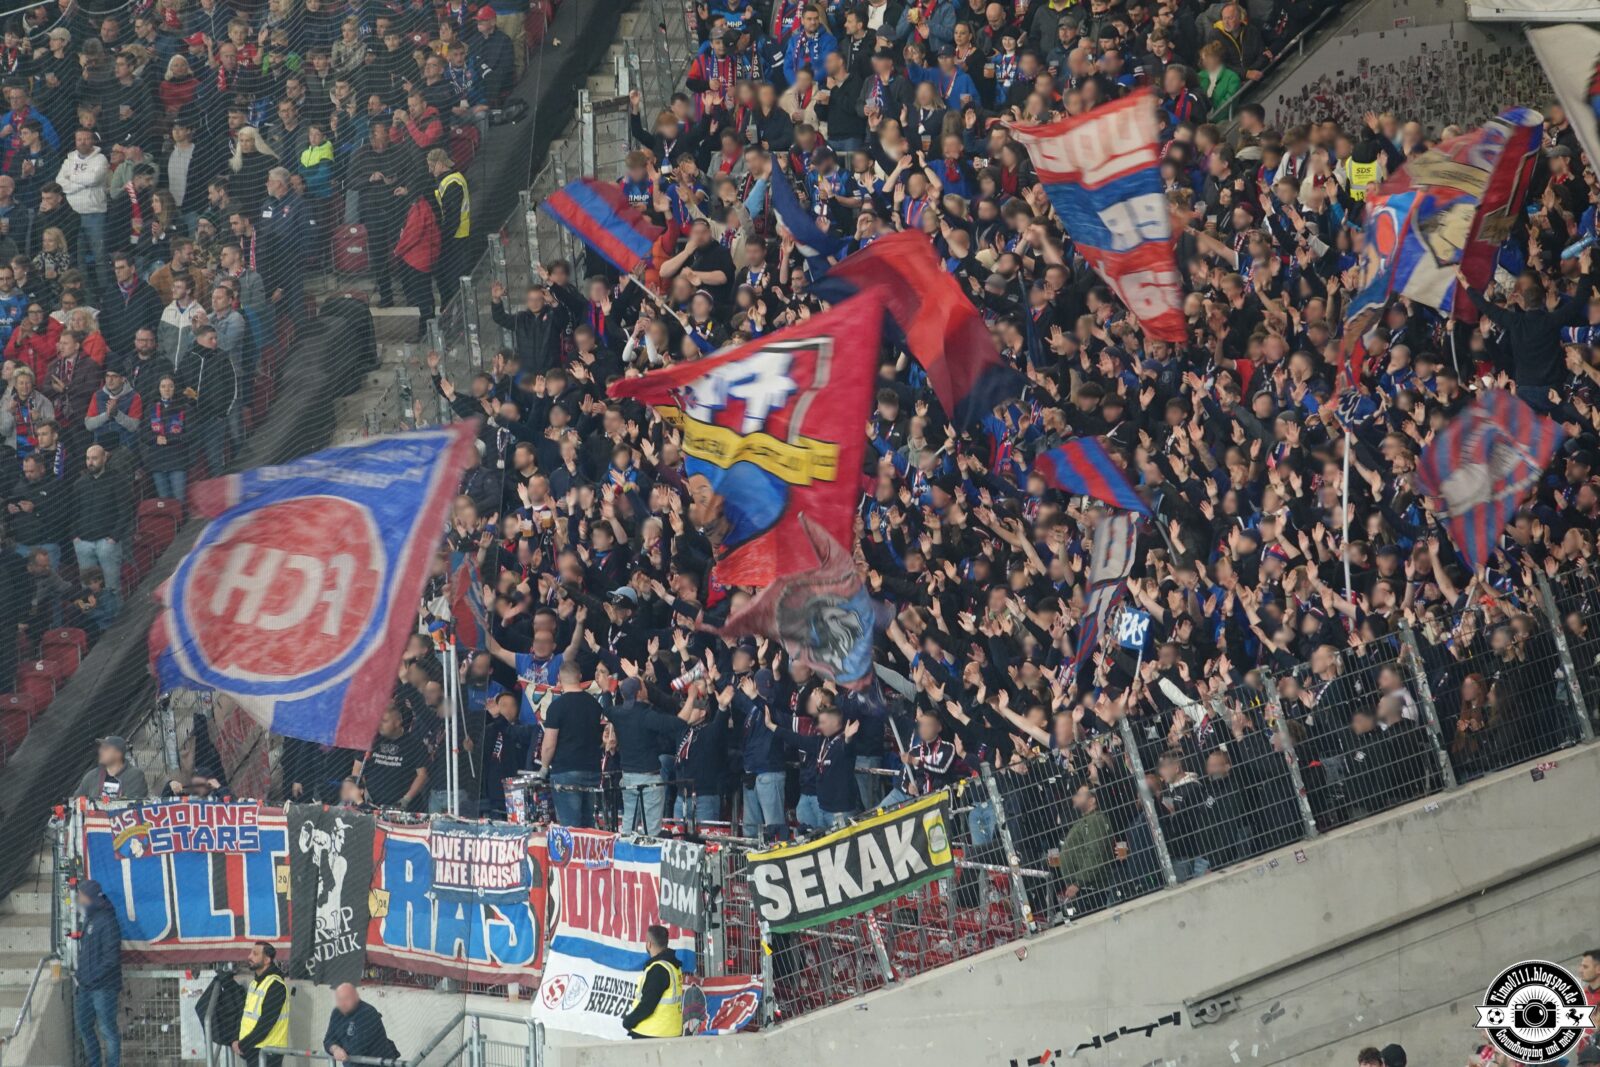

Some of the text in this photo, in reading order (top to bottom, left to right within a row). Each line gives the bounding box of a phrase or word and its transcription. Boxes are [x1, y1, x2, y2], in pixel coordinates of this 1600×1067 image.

[726, 20, 743, 28] MHP
[142, 803, 260, 829] YOUNG
[149, 825, 260, 854] STARS
[431, 835, 526, 865] LOVE FOOTBALL
[435, 860, 521, 888] HATE RACISM
[754, 817, 928, 921] SEKAK
